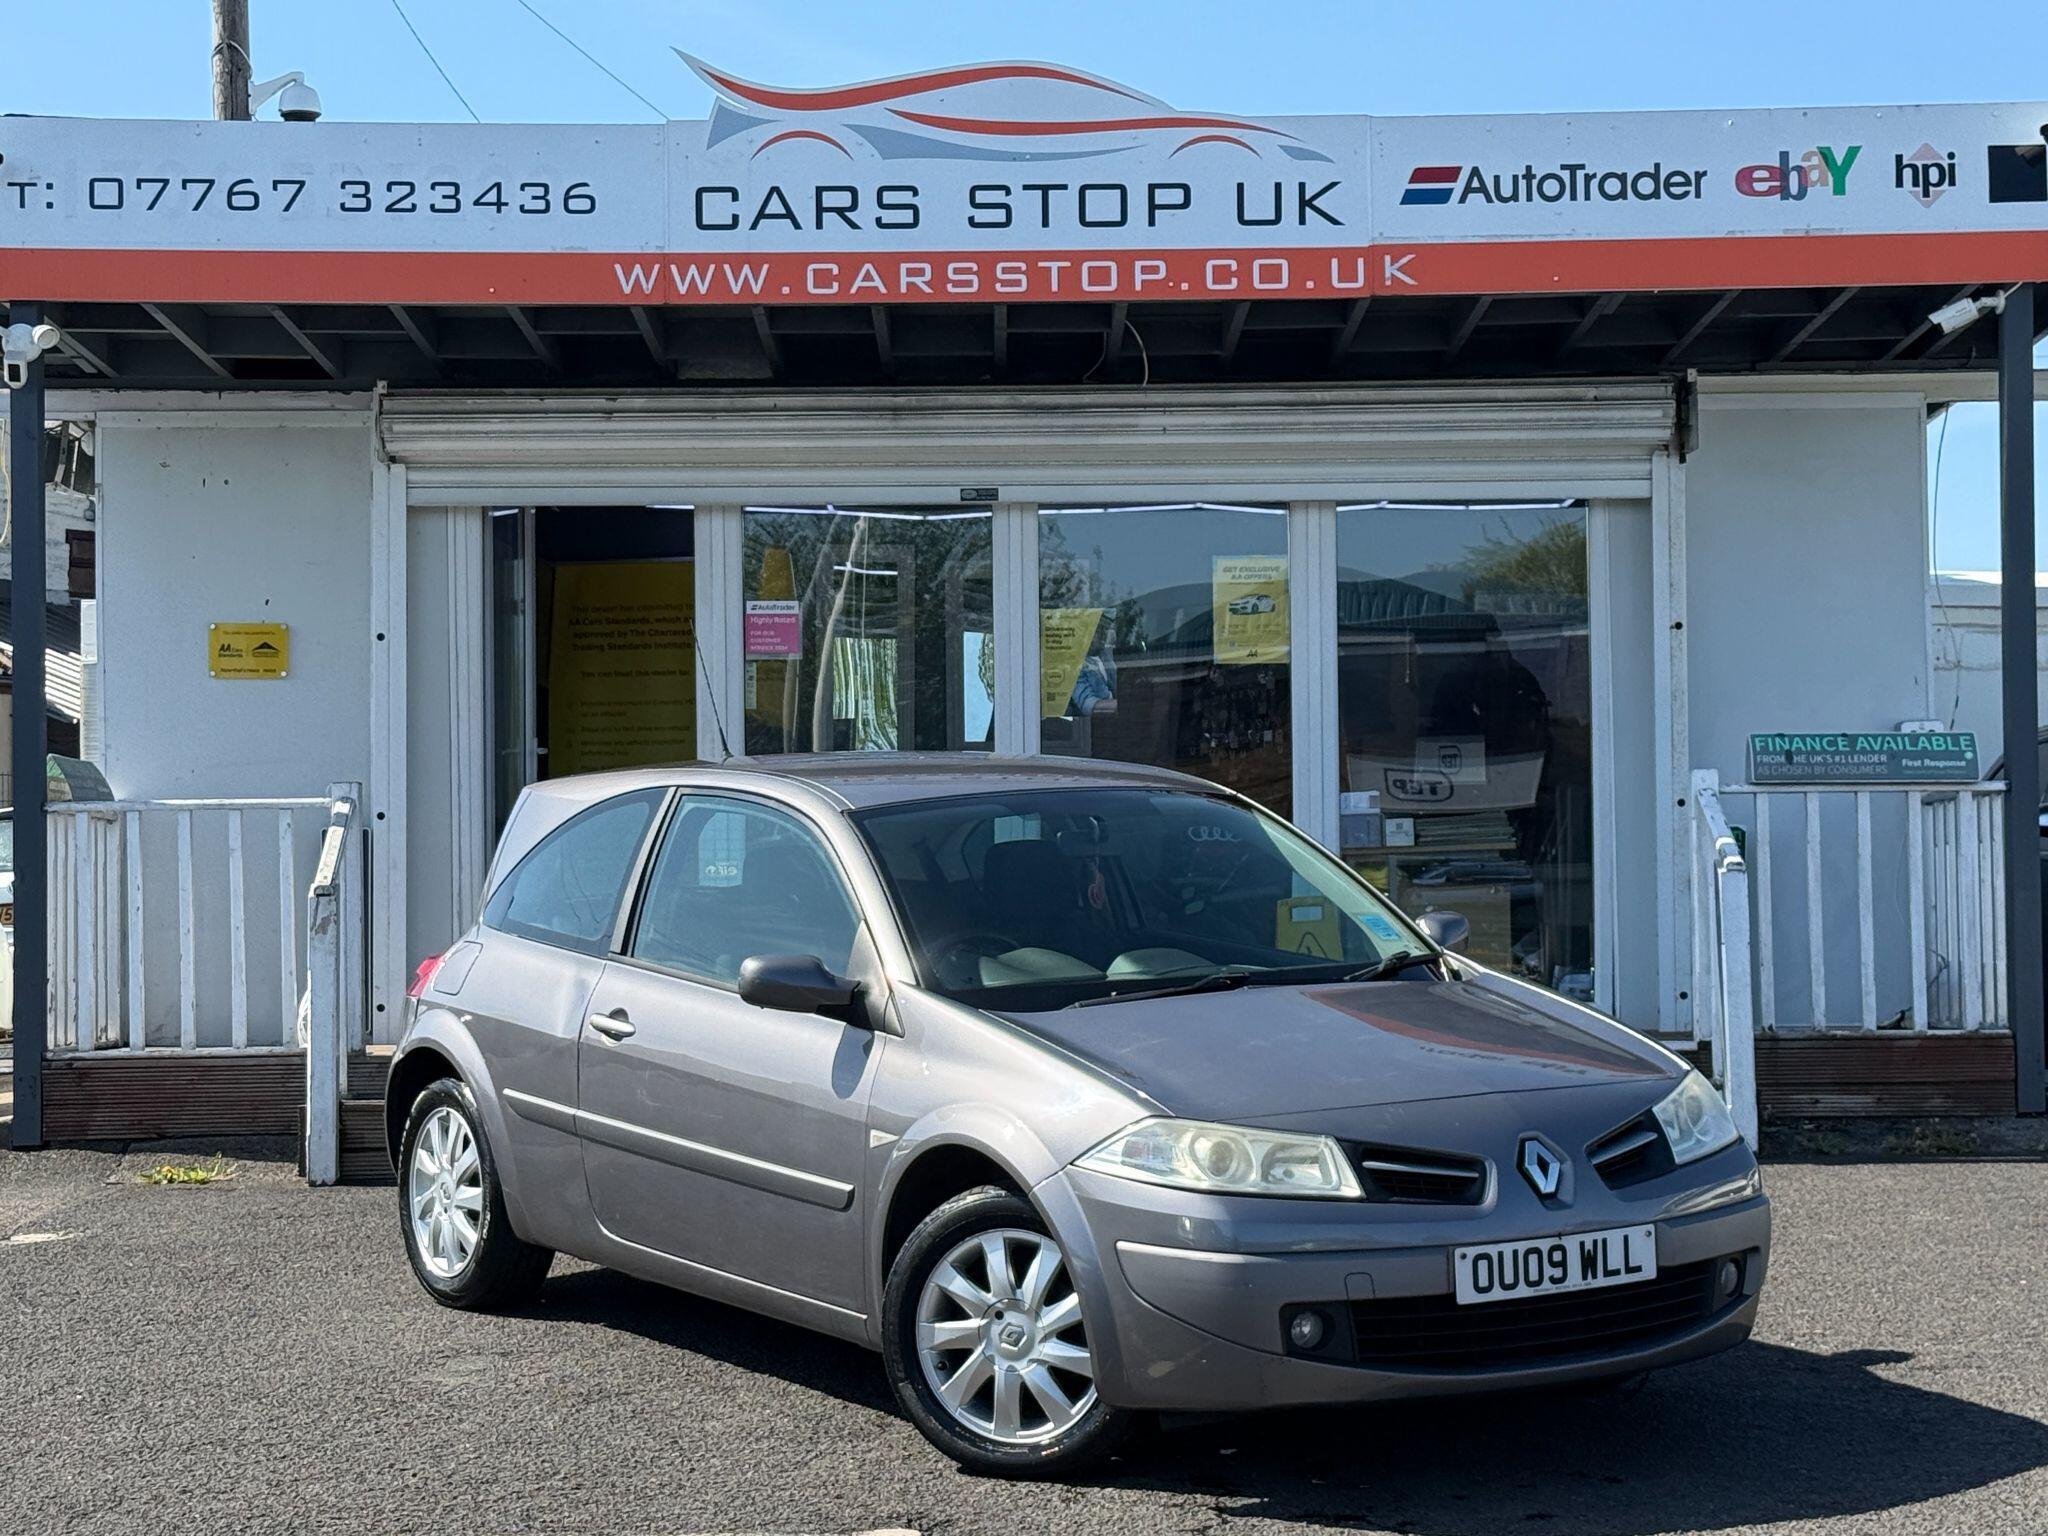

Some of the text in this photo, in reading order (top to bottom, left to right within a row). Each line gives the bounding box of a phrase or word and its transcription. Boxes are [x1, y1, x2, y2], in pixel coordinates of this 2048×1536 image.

[1895, 151, 1957, 199] hpi
[1457, 162, 1708, 205] AutoTrader
[7, 178, 597, 214] T: 07767 323436
[694, 181, 1346, 231] CARS STOP UK
[614, 254, 1418, 296] WWW.CARSSTOP.CO.UK
[758, 603, 796, 611] AutoTrader
[750, 616, 796, 625] Highly Rated
[218, 643, 232, 653] AA
[1754, 735, 1974, 751] FINANCE AVAILABLE
[1756, 754, 1785, 764] FROM
[1809, 754, 1833, 764] UK'S
[1833, 754, 1847, 763] #1
[1848, 754, 1888, 763] LENDER
[1901, 758, 1967, 768] First Response
[1756, 765, 1888, 775] AS CHOSEN BY CONSUMERS
[1471, 1234, 1643, 1295] OU09 WLL
